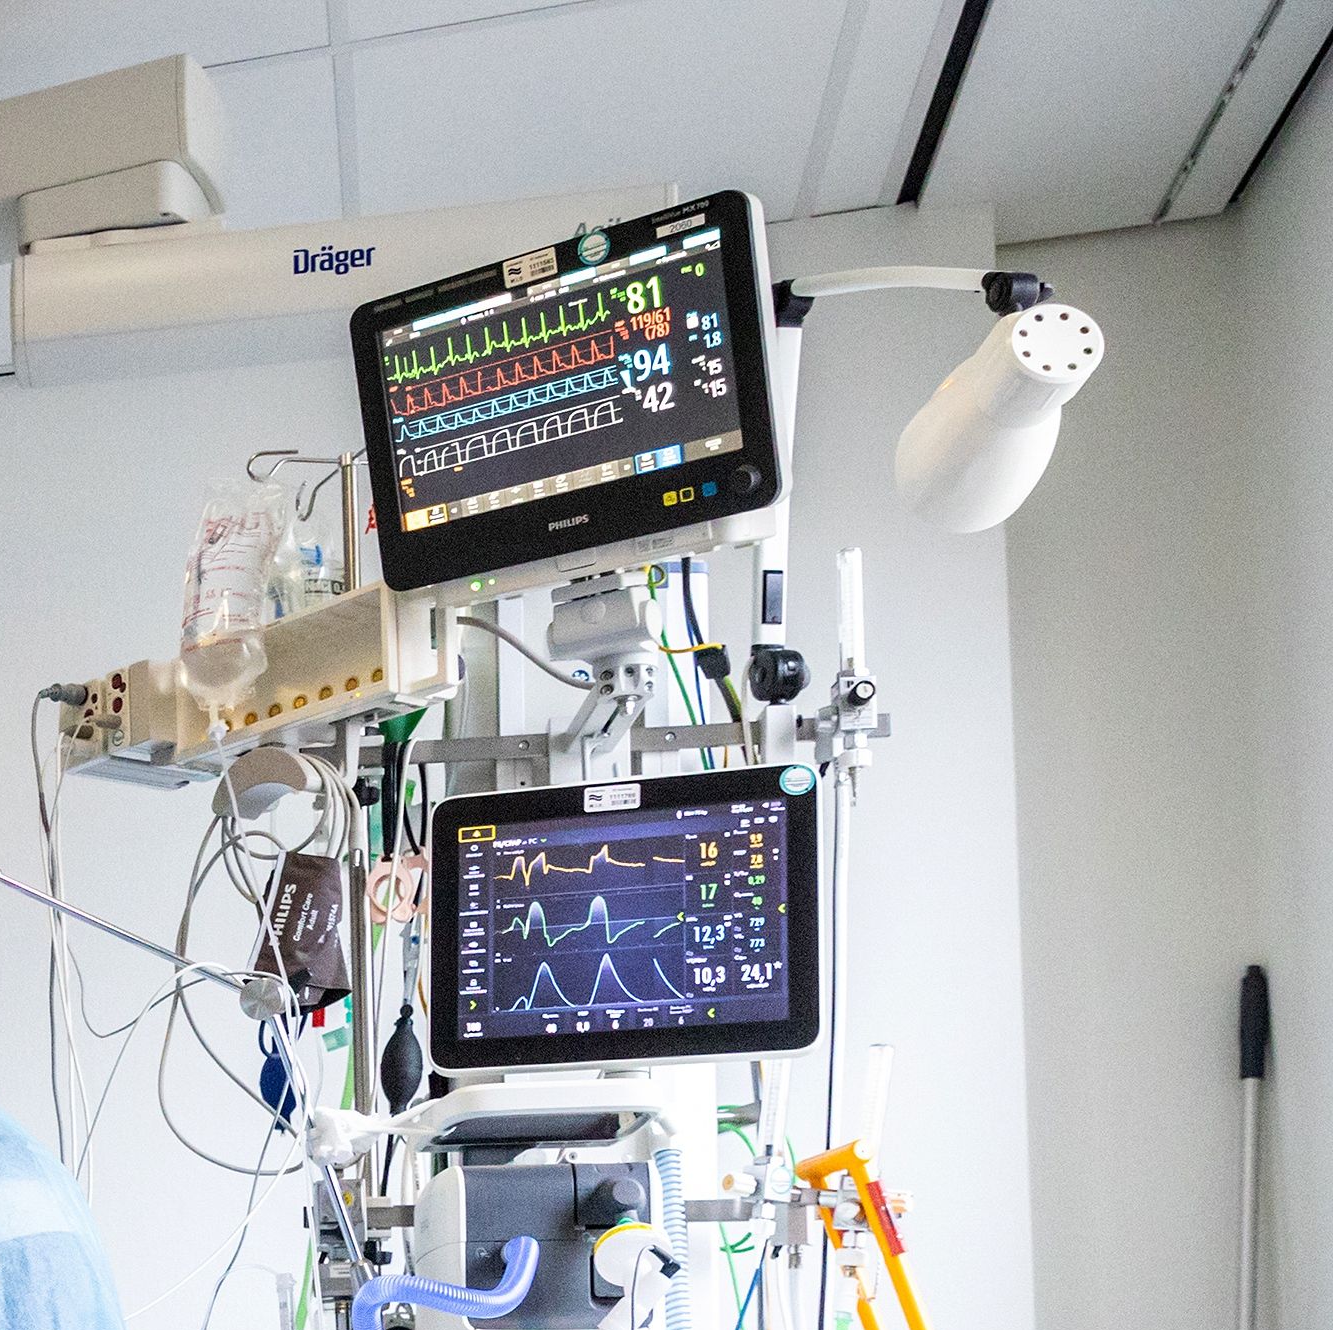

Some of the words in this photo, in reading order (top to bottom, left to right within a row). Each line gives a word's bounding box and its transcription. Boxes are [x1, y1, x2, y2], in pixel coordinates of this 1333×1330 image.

[293, 245, 375, 275] Dräger
[626, 275, 662, 314] 81
[630, 306, 671, 331] 119/61
[701, 312, 719, 331] 81
[644, 322, 670, 341] (78)
[633, 342, 671, 382] 94
[706, 358, 723, 375] 15
[642, 381, 675, 413] 42
[709, 378, 727, 398] 15
[548, 514, 590, 532] PHILIPS
[700, 842, 718, 859] 16
[700, 883, 718, 900] 17
[693, 924, 725, 944] 12,3
[693, 966, 726, 986] 10,3
